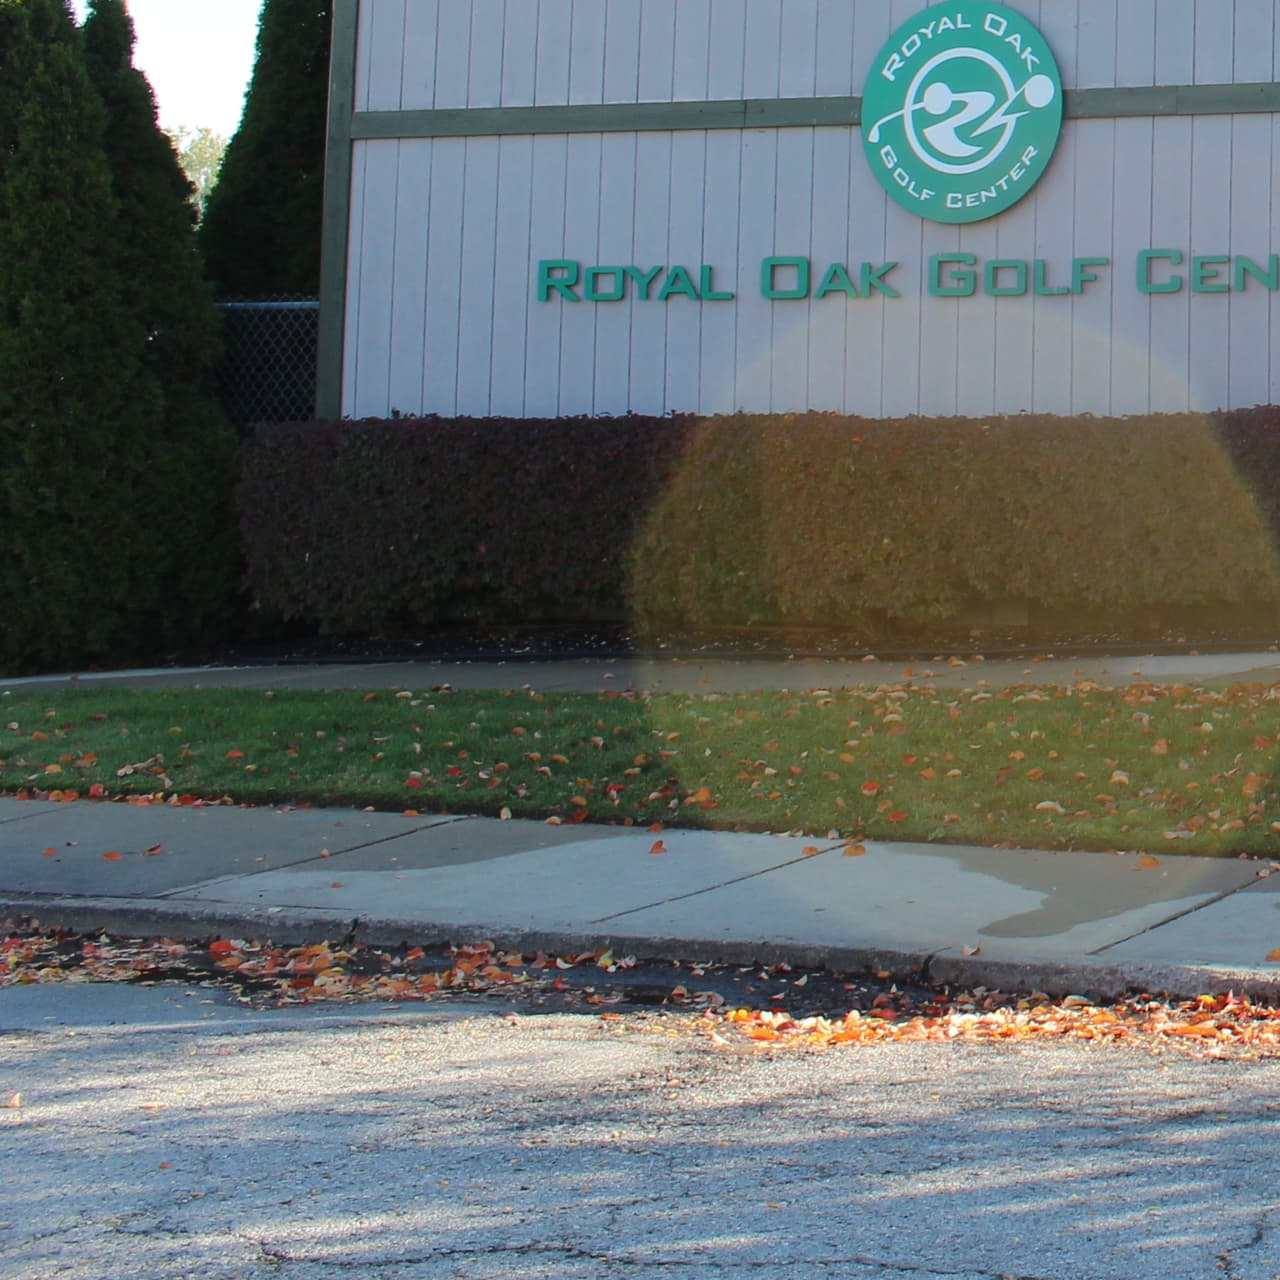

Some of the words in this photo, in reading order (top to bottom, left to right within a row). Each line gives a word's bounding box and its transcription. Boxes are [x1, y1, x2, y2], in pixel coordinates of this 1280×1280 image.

[881, 13, 971, 81] ROYAL
[984, 13, 1040, 73] OAK
[880, 145, 935, 201] GOLF
[946, 145, 1038, 208] CENTER
[537, 259, 735, 302] ROYAL
[761, 256, 899, 300] OAK
[927, 253, 1110, 297] GOLF
